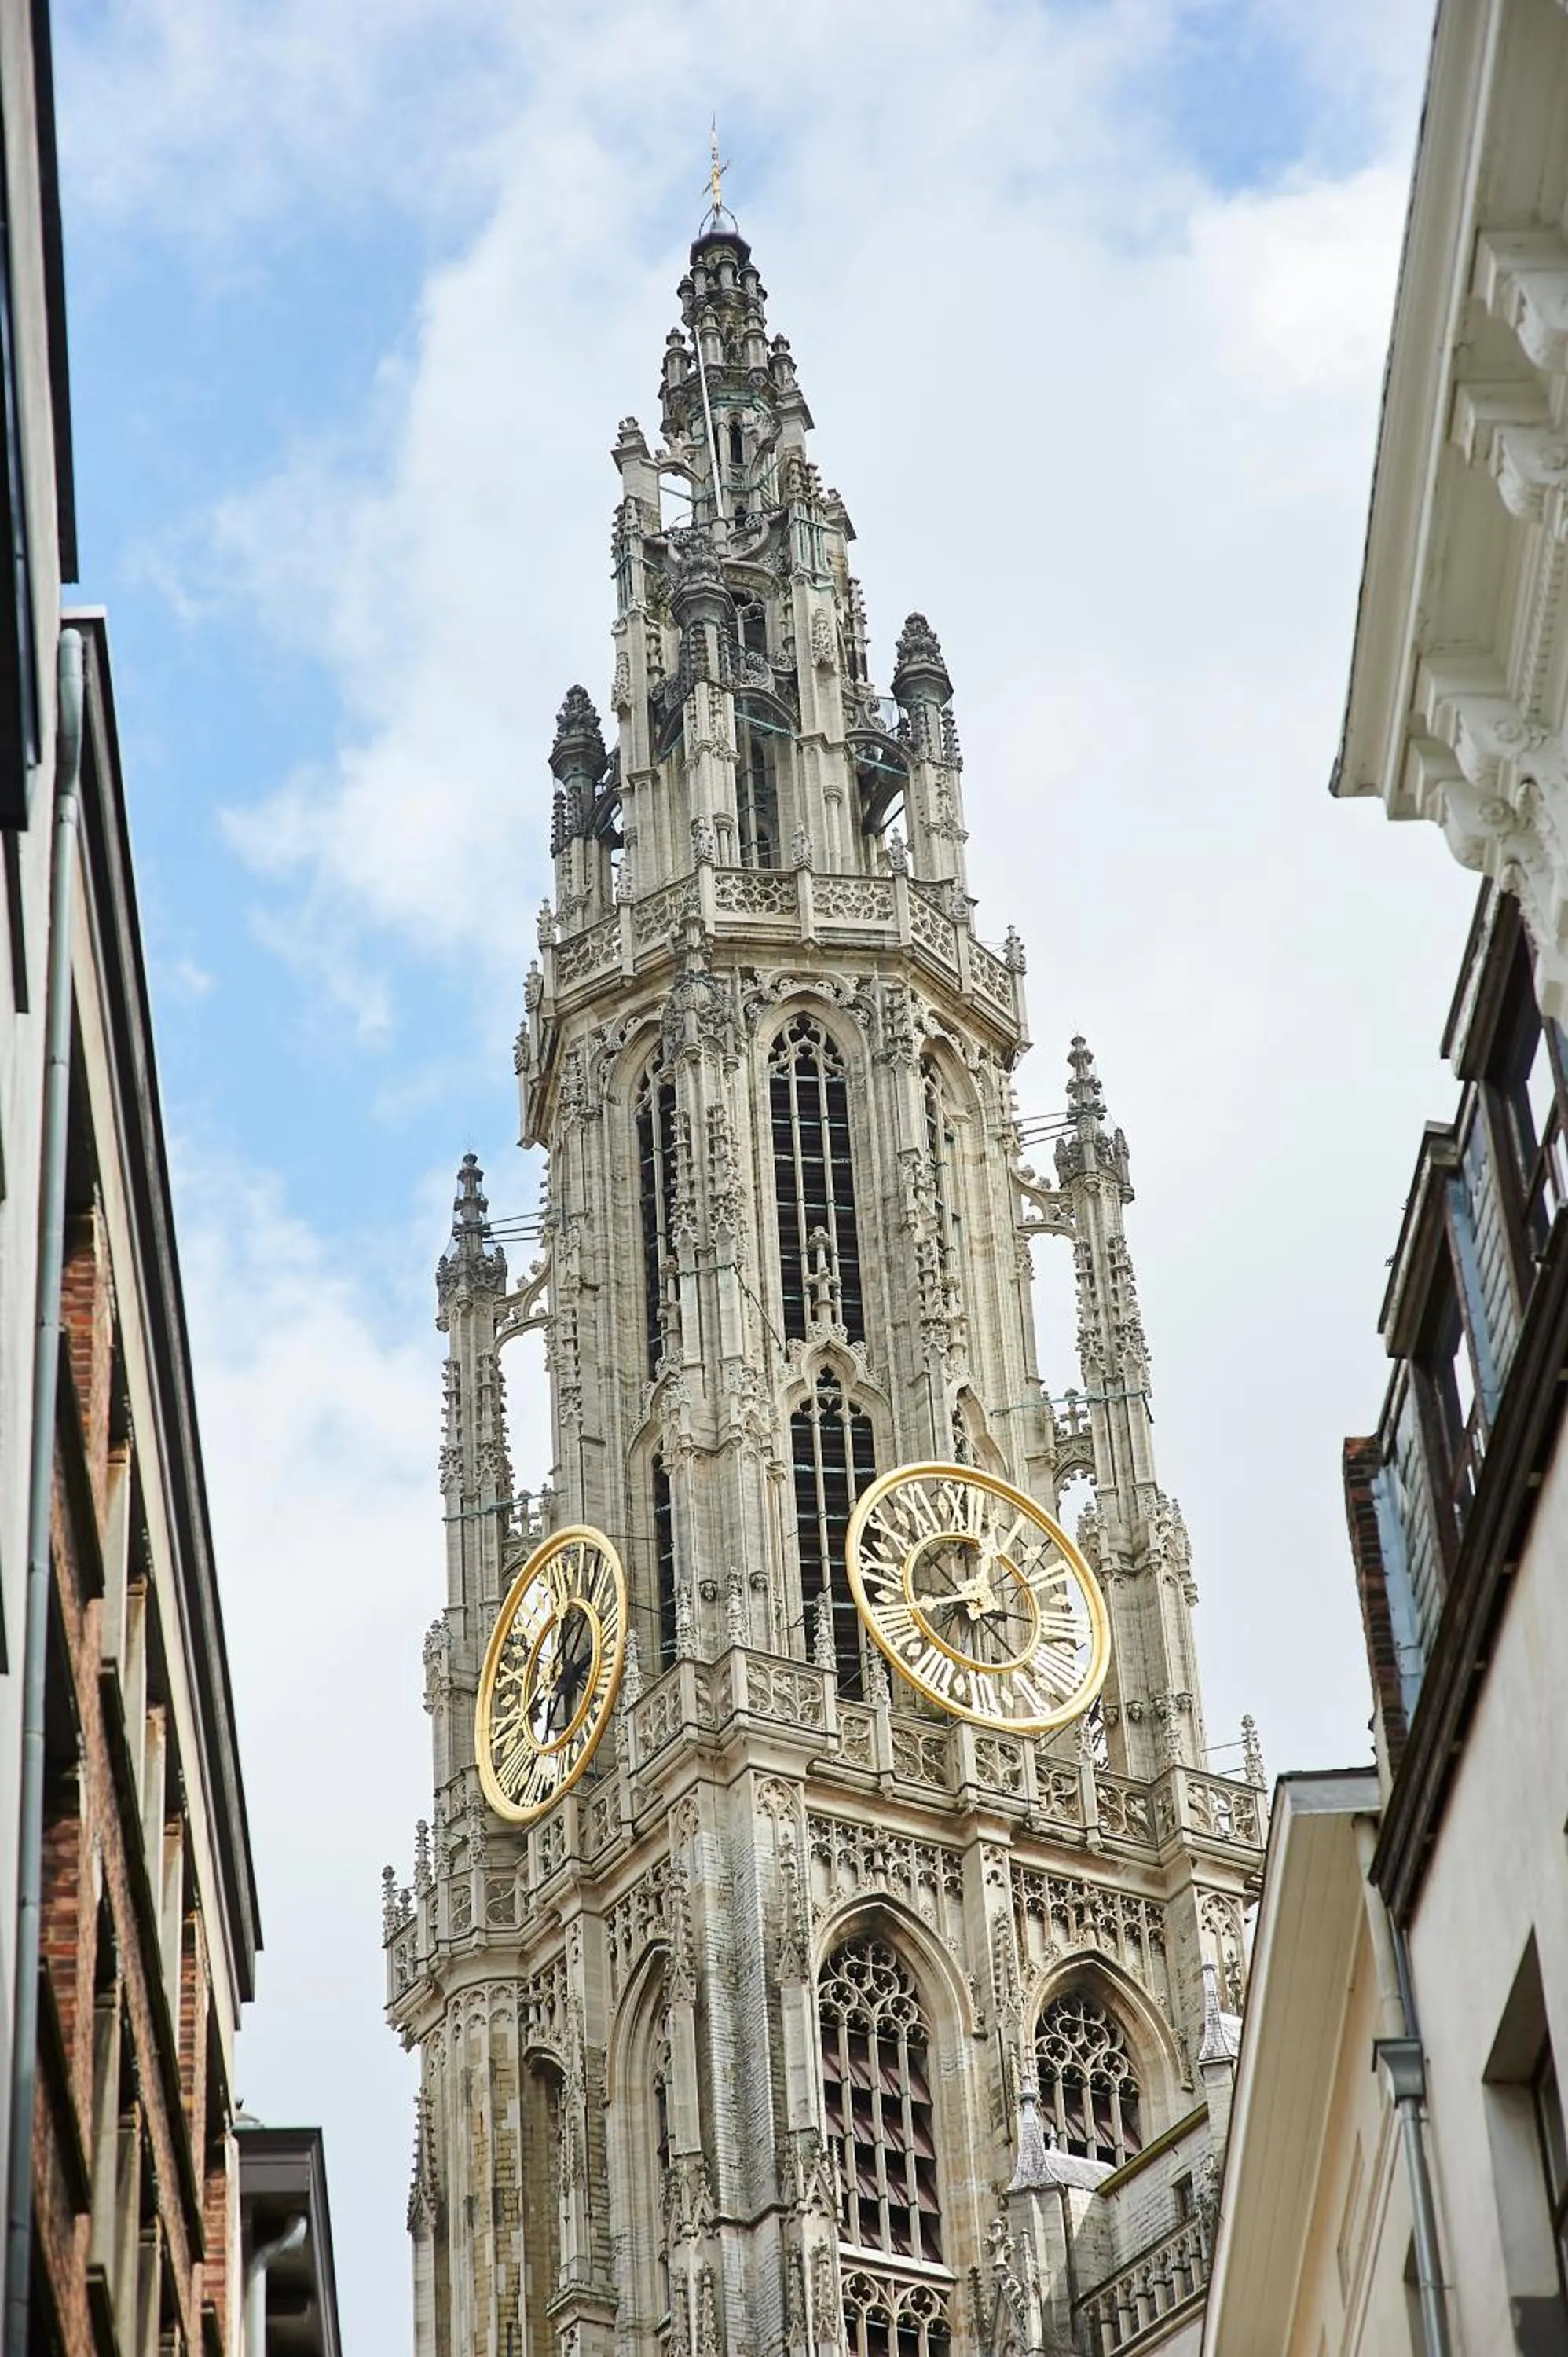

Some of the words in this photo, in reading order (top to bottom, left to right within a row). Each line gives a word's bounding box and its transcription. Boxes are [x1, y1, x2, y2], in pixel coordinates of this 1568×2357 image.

[896, 1482, 942, 1540] XI
[943, 1480, 986, 1534] XII
[868, 1506, 914, 1558] X
[1001, 1513, 1030, 1554] I
[859, 1545, 904, 1592] IX
[1027, 1559, 1074, 1592] II
[1039, 1611, 1090, 1640] III
